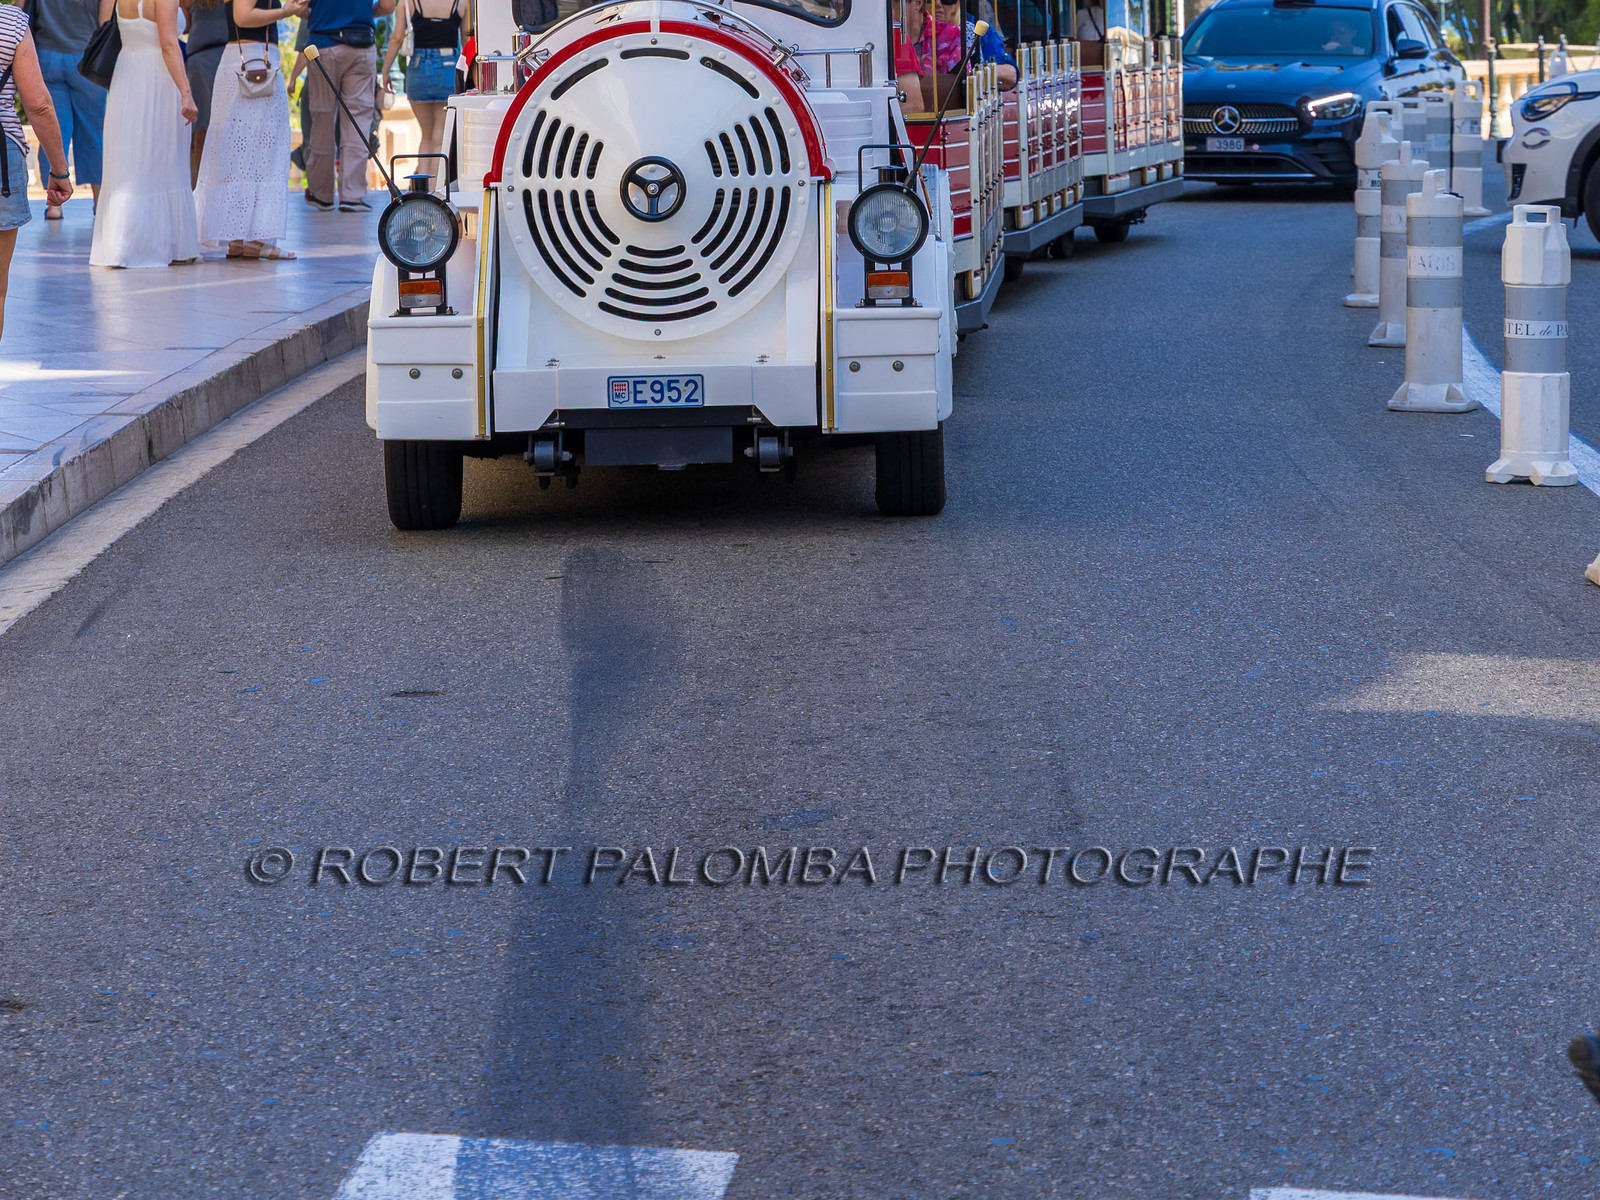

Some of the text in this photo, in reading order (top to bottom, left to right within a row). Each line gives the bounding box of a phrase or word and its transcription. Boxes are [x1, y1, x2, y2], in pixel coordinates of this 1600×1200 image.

[1504, 322, 1535, 336] TEL
[1539, 325, 1553, 336] de
[614, 378, 699, 404] MC E952
